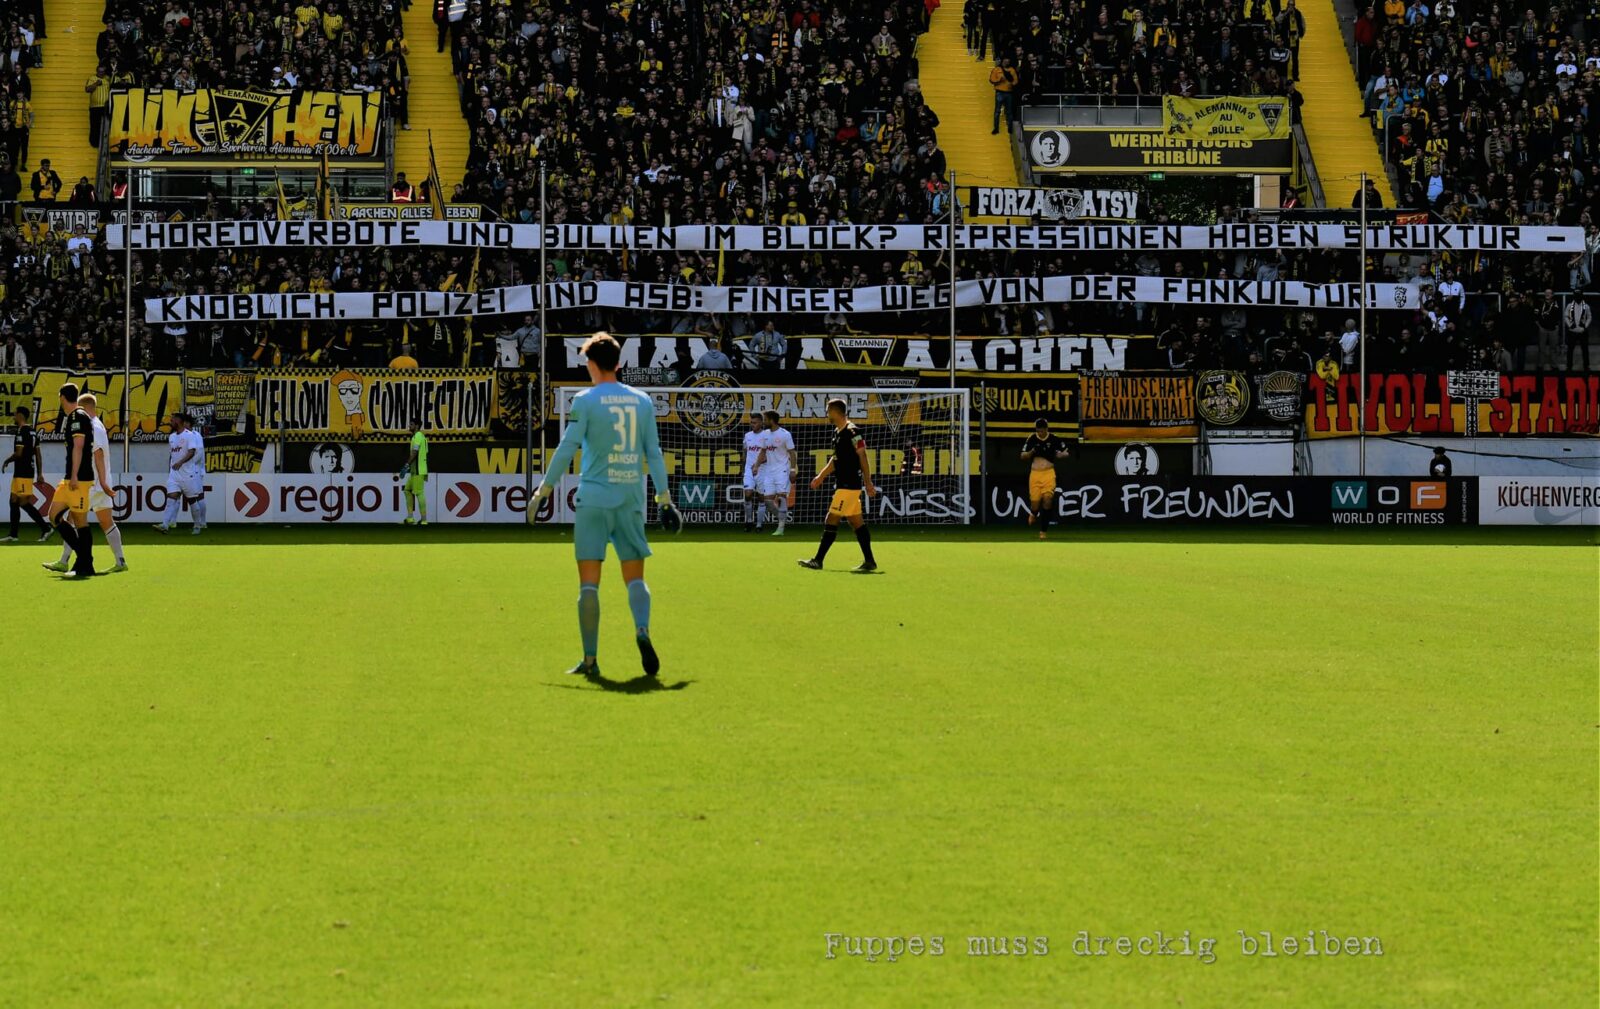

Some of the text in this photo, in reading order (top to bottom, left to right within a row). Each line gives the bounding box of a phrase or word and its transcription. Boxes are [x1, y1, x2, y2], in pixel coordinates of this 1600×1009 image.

[215, 89, 270, 104] ALEMANNIA
[270, 142, 312, 154] Alemannia
[1109, 134, 1187, 148] WERNER
[1141, 149, 1222, 165] TRIBÜNE
[351, 206, 397, 219] AACHEN
[401, 206, 432, 219] ALLES
[446, 207, 479, 218] EBEN!
[977, 188, 1138, 219] FORZA ATSV
[123, 222, 420, 248] CHOREOVERBOTE
[448, 222, 512, 247] UND
[544, 225, 676, 248] BULLEN
[705, 226, 735, 249] IM
[763, 226, 897, 249] BLOCK?
[924, 226, 1181, 248] REPRESSIONEN
[1209, 225, 1318, 248] HABEN
[1344, 226, 1520, 249] STRUKTUR
[162, 294, 345, 321] KNOBLICH,
[373, 288, 505, 317] POLIZEI
[531, 282, 597, 309] UND
[728, 287, 853, 312] FINGER
[881, 285, 949, 310] WEG
[979, 278, 1043, 303] VON
[1071, 276, 1136, 300] DER
[1164, 278, 1376, 308] FANKULTUR!
[903, 338, 1128, 371] AACHEN
[256, 379, 329, 429] YELLOW
[368, 379, 493, 430] CONNECTION
[1000, 387, 1073, 413] WACHT
[1309, 373, 1454, 432] TIVOLI
[608, 405, 637, 452] 31
[809, 444, 981, 475] TIBÜNE
[280, 476, 382, 522] regio
[861, 483, 1294, 519] TNESS UNER FREUNDEN
[1498, 481, 1600, 508] KÜCHENVERG
[681, 511, 718, 523] WORLD
[725, 511, 741, 523] OF
[1332, 512, 1445, 524] WORLD OF FITNESS
